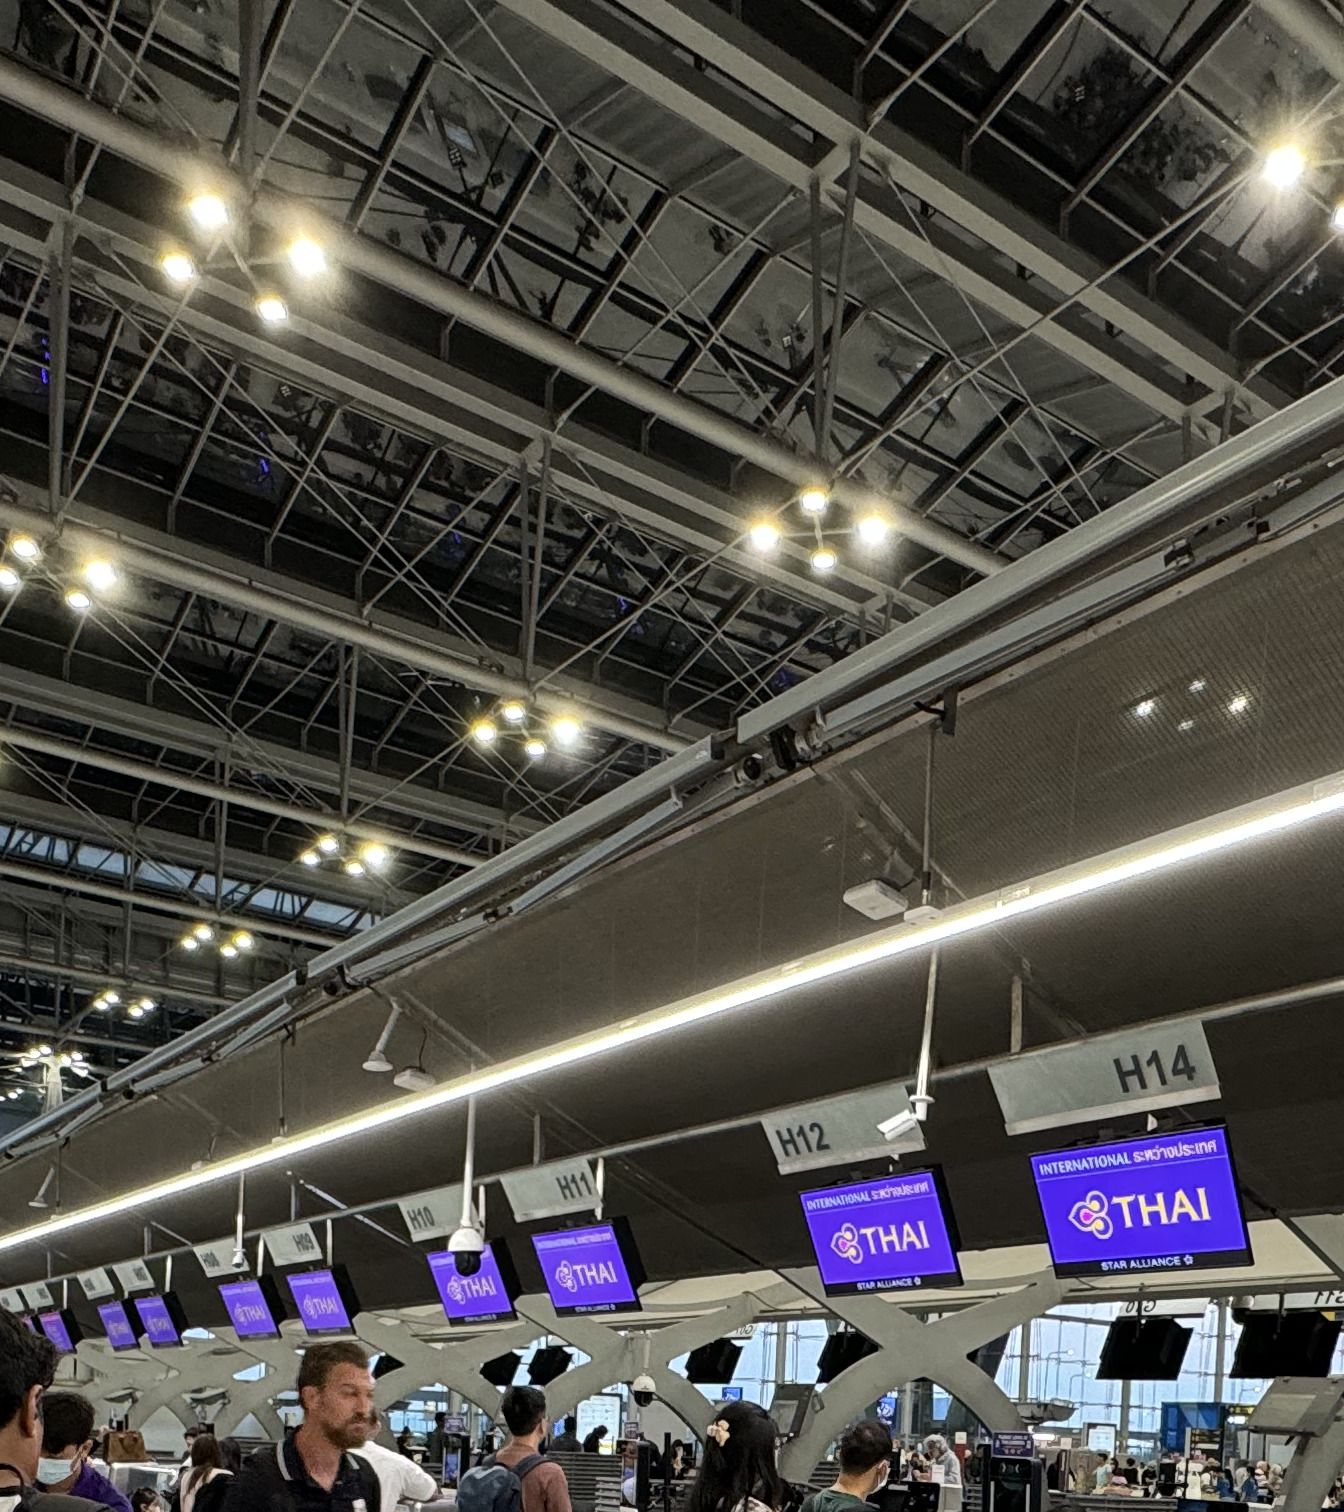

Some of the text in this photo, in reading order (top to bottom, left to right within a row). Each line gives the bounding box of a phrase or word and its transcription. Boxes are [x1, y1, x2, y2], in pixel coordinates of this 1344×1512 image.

[1113, 1044, 1197, 1094] H14
[776, 1122, 831, 1157] H12
[1039, 1151, 1132, 1177] INTERNATIONAL
[556, 1171, 594, 1201] H11
[807, 1190, 872, 1211] INTERNATIONAL
[1110, 1187, 1212, 1229] THAI
[406, 1206, 436, 1230] H10
[859, 1220, 931, 1256] THAI
[573, 1260, 618, 1287] THAI
[1100, 1256, 1182, 1271] STAR ALLIANCE
[461, 1275, 498, 1299] THAI
